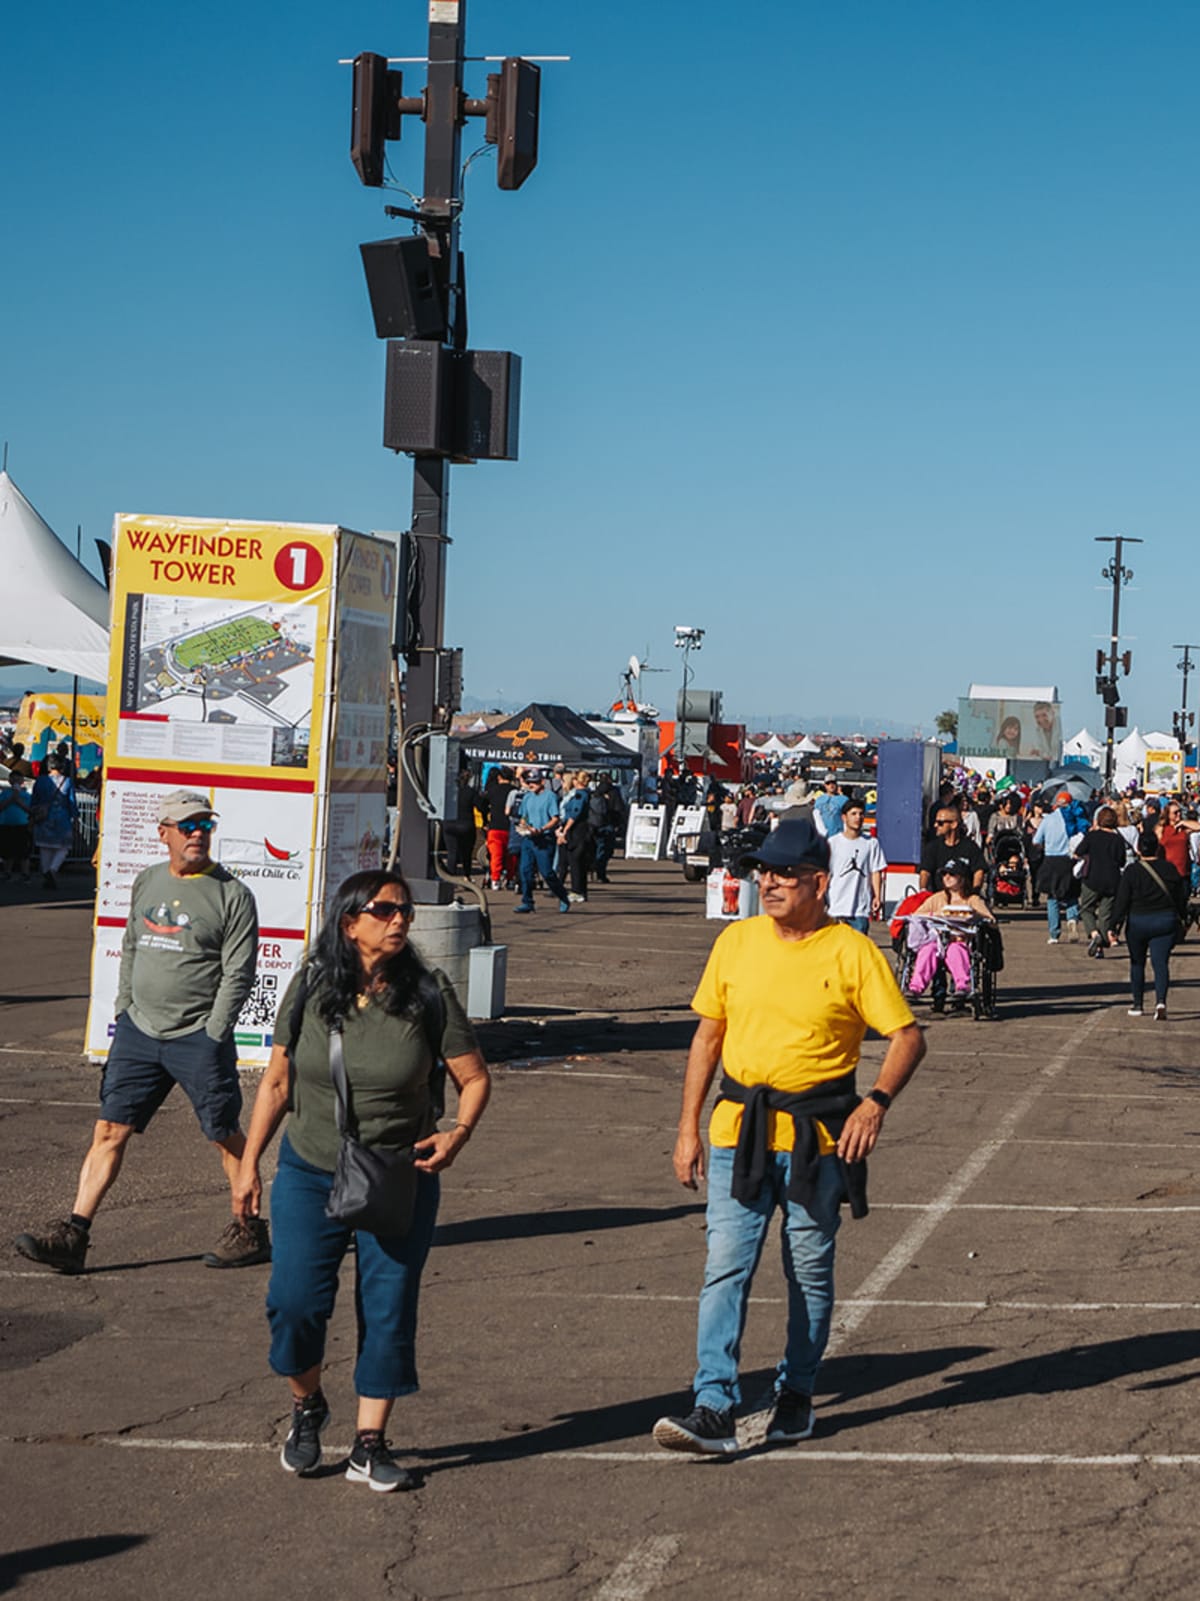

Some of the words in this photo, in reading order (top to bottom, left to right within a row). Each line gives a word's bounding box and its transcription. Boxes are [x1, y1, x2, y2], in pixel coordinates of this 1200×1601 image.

[127, 530, 263, 560] WAYFINDER
[150, 559, 236, 586] TOWER
[289, 547, 308, 585] 1
[465, 748, 487, 759] NEW
[487, 750, 524, 761] MEXICO
[261, 867, 285, 879] Chile
[286, 869, 301, 881] Co.
[264, 961, 292, 970] DEPOT
